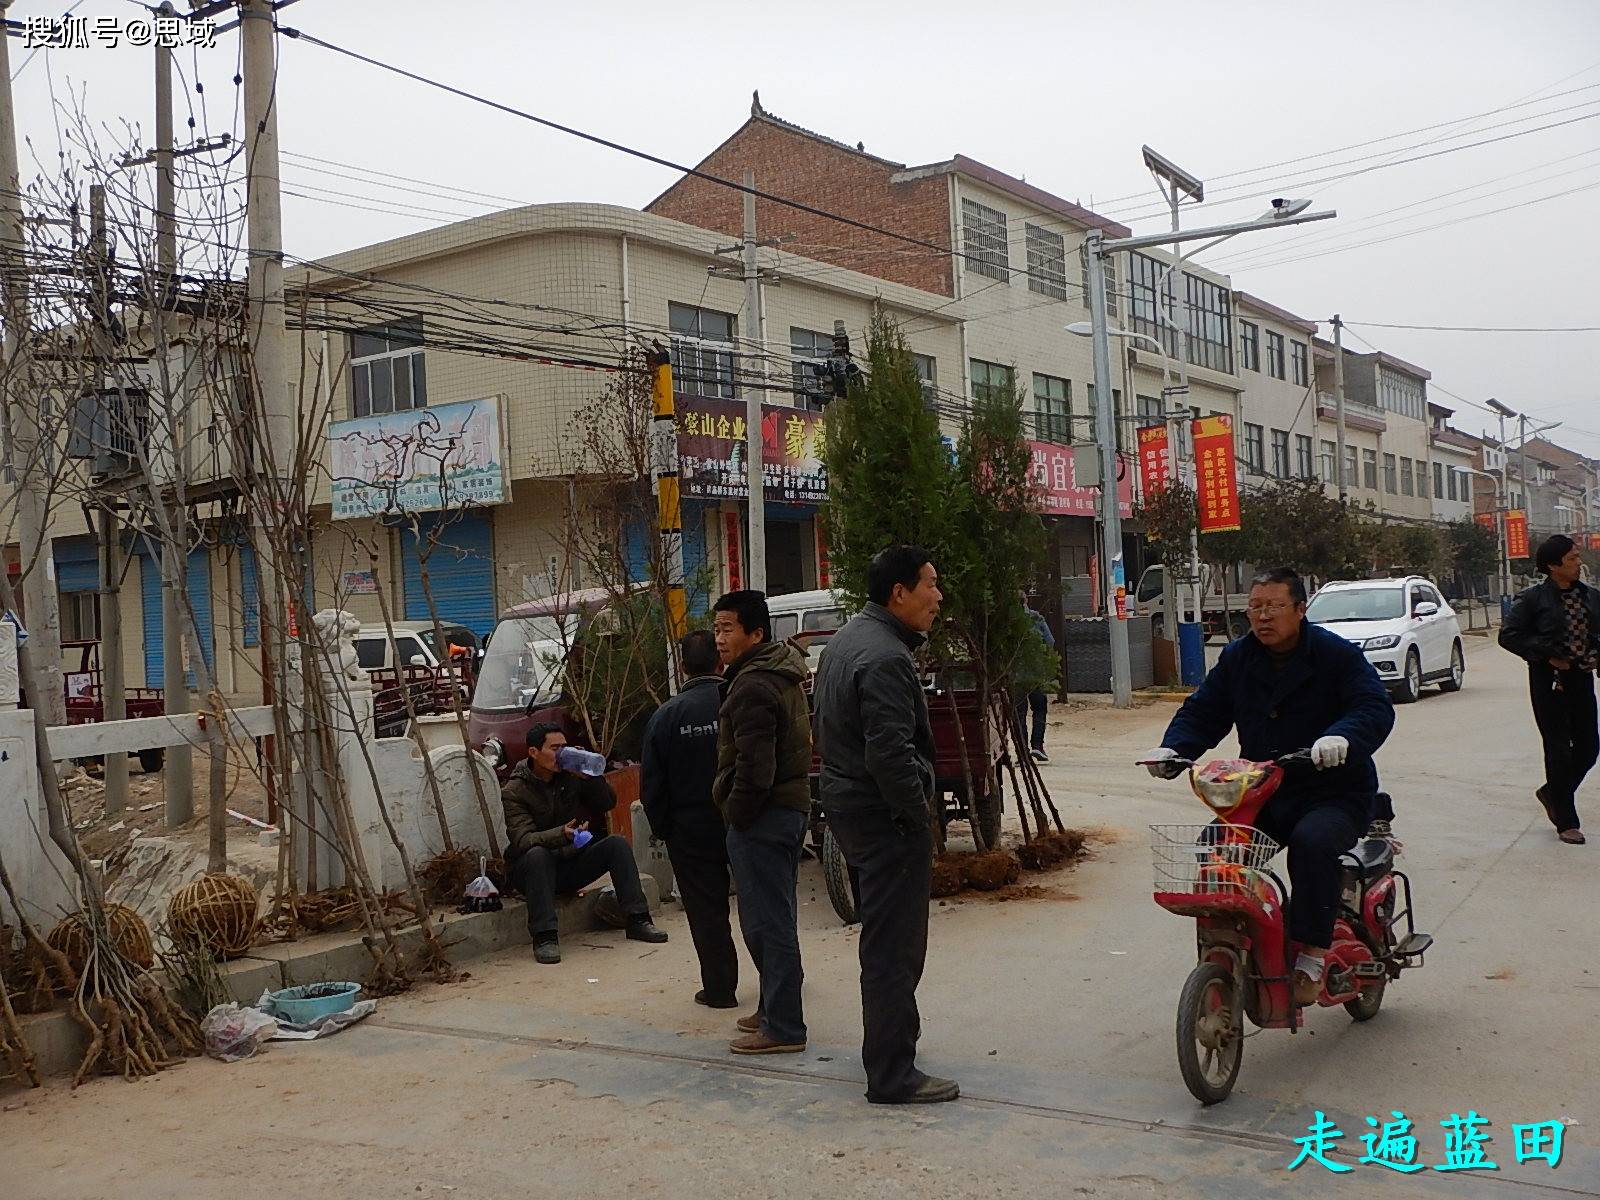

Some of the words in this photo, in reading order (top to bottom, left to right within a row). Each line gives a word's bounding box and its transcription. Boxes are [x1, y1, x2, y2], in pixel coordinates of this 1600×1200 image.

[1203, 449, 1218, 519] 金融便利送到家
[1216, 447, 1231, 518] 惠民支付服务点
